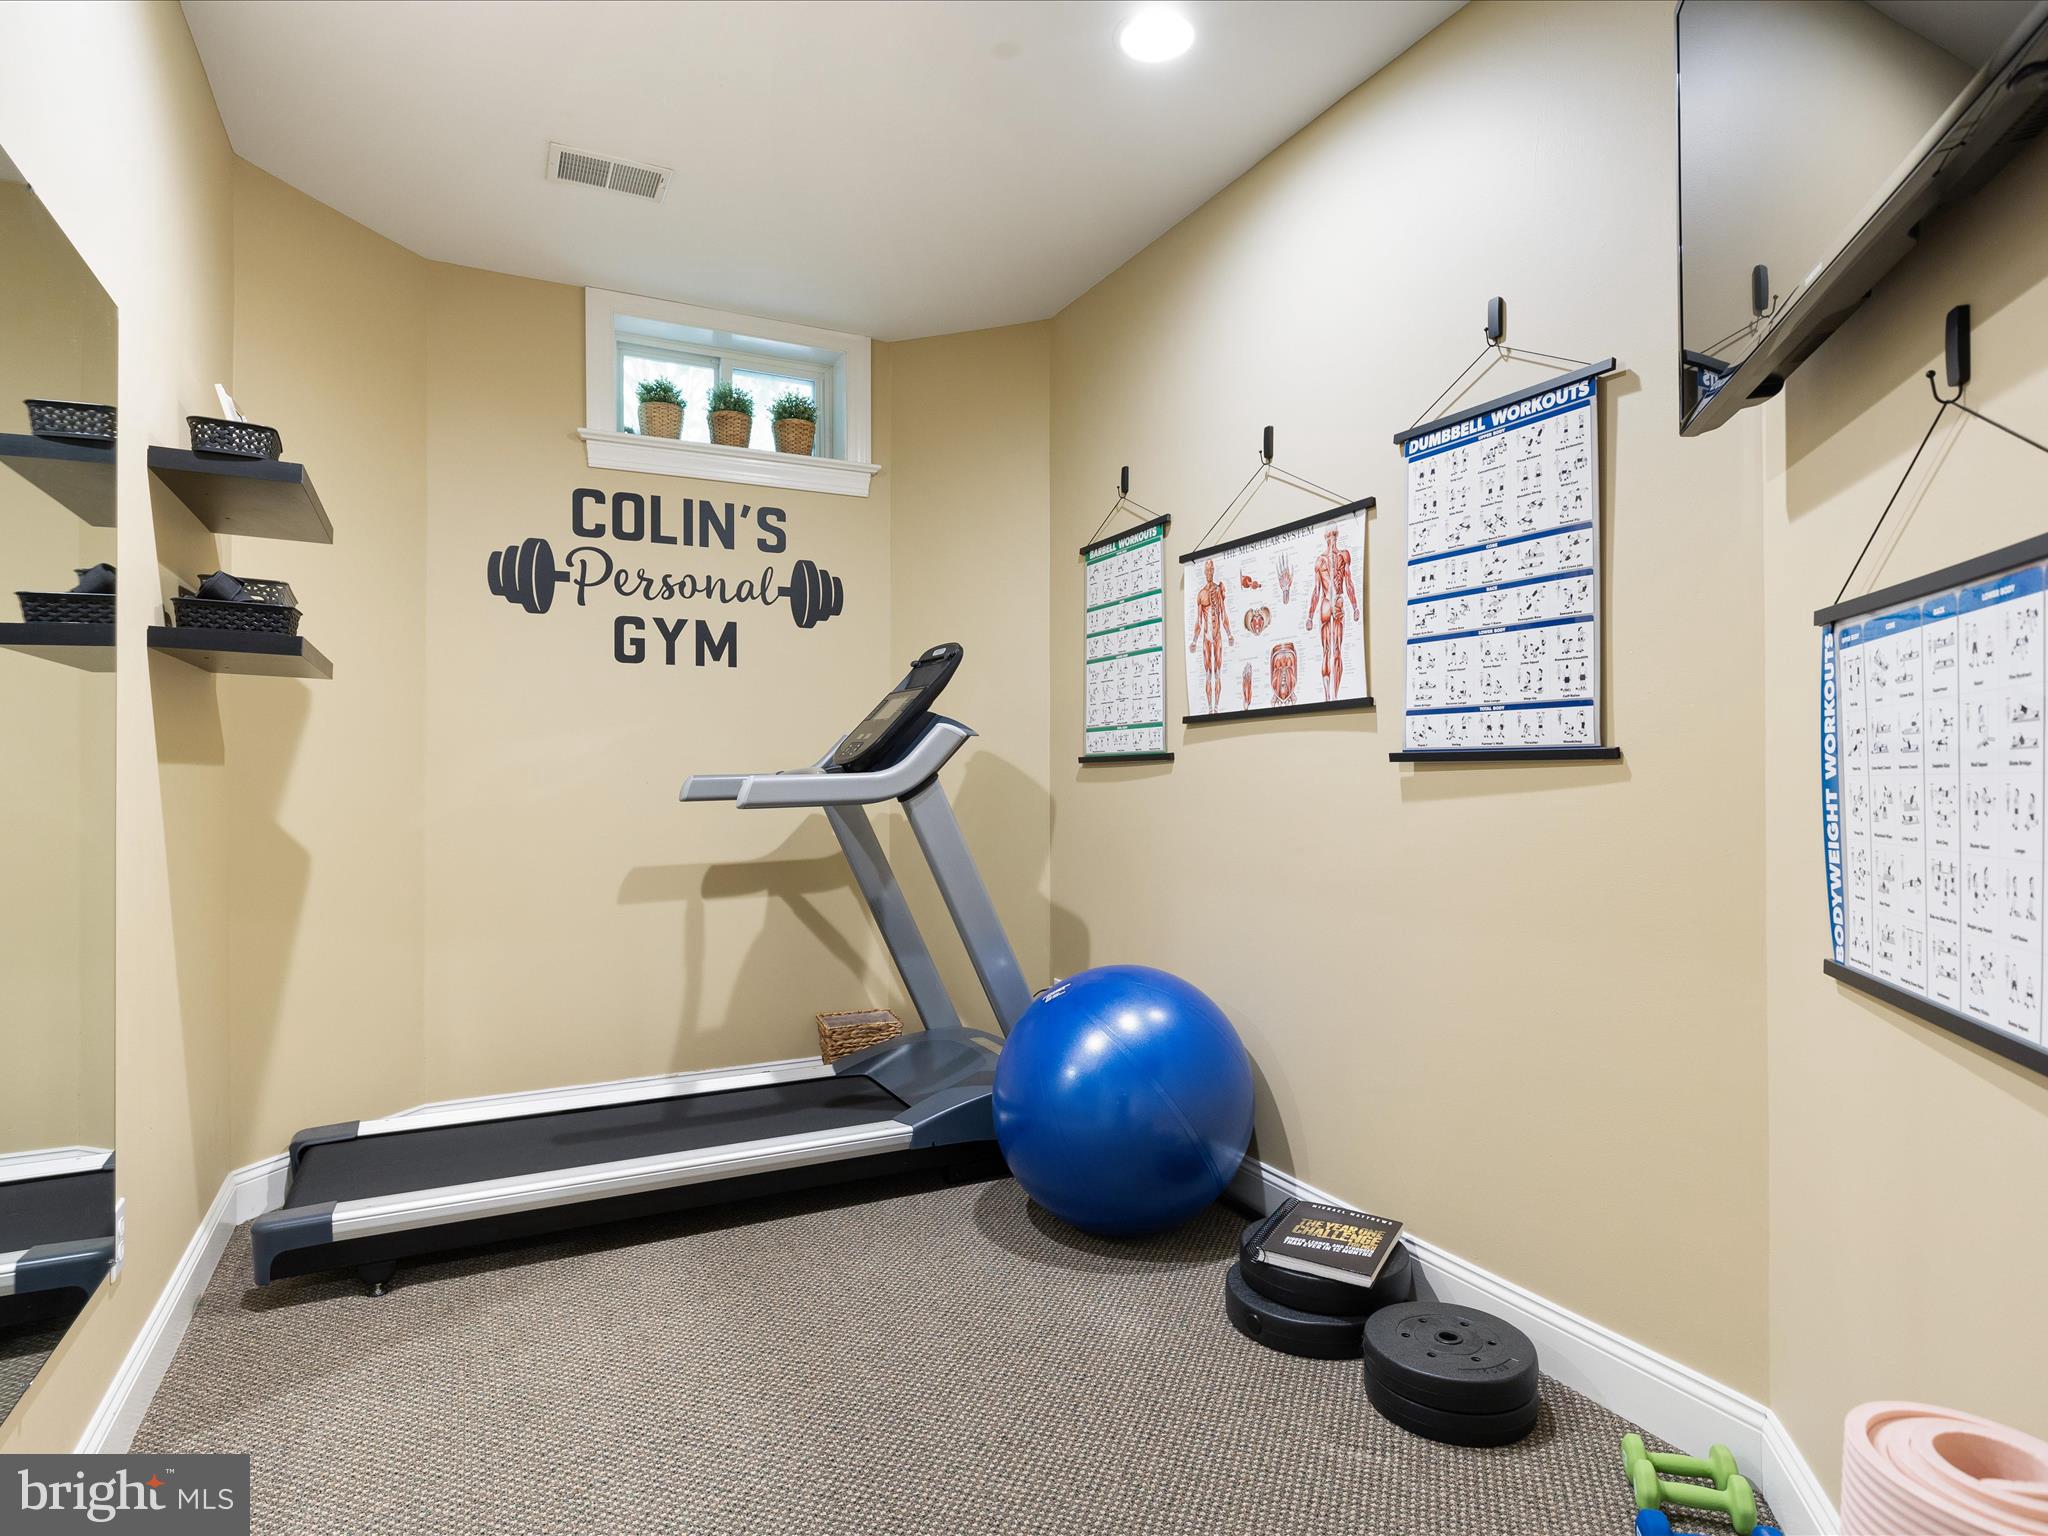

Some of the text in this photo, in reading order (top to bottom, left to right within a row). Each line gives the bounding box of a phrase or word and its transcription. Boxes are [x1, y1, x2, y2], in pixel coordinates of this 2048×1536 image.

[1408, 381, 1590, 454] DUMBBELL WORKOUTS
[572, 488, 787, 553] COLIN'S
[1090, 542, 1117, 559] BARBELL
[1118, 526, 1157, 548] WORKOUTS
[1223, 525, 1315, 560] THE MUSCULAR SYSTEM
[565, 546, 779, 606] Personal
[614, 615, 738, 668] GYM
[1823, 633, 1845, 963] BODYWEIGHT WORKOUTS
[1298, 1217, 1387, 1239] THE YEAR ONE
[1311, 1203, 1393, 1226] MICHAEL MATTHEWS
[1283, 1239, 1303, 1247] THAN
[1303, 1242, 1323, 1250] EVER
[1341, 1247, 1374, 1258] MONTHS
[1291, 1224, 1383, 1246] CHALLENGE
